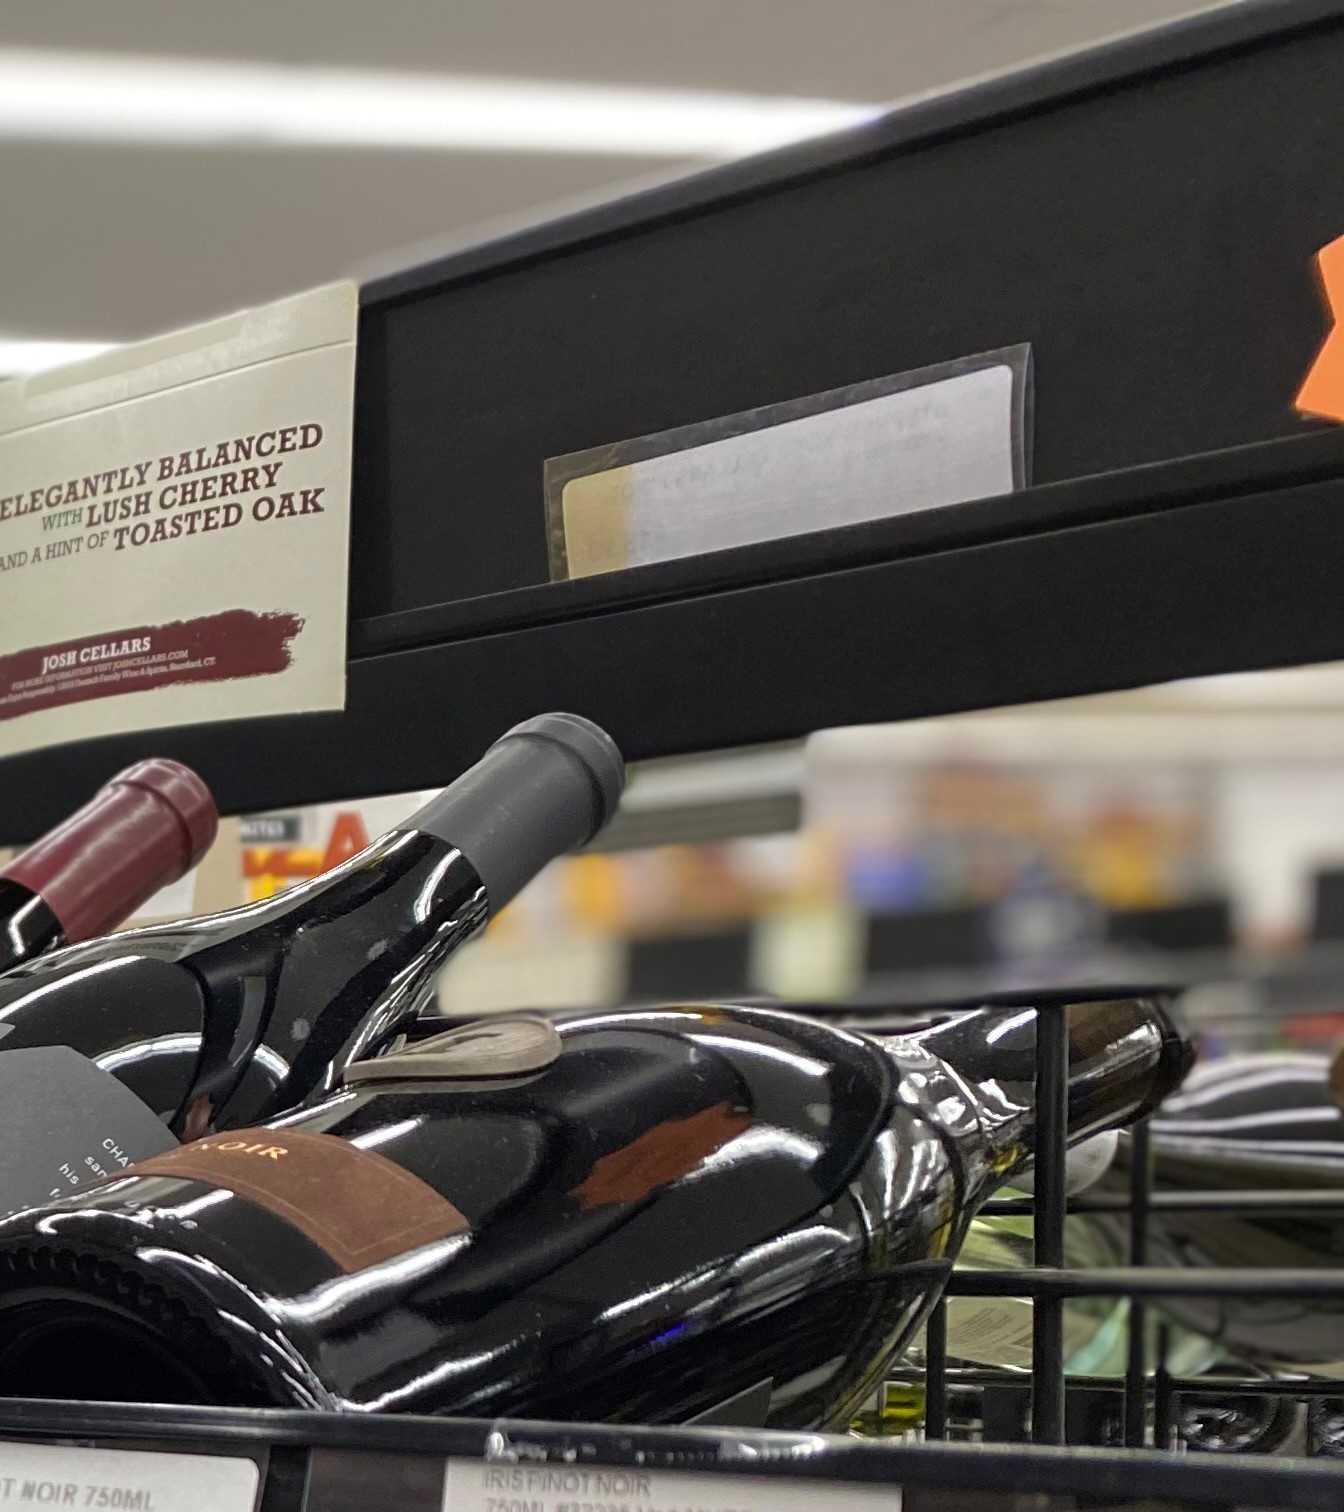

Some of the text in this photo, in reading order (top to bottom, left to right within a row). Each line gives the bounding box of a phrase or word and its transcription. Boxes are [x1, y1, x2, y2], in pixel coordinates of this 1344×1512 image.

[157, 422, 324, 483] BALANCED
[42, 461, 283, 531] WITH LUSH CHERRY
[31, 546, 42, 563] A
[45, 537, 83, 559] HINT
[87, 531, 109, 550] OF
[113, 503, 243, 551] TOASTED
[251, 488, 325, 523] OAK
[42, 636, 151, 675] JOSH CELLARS
[58, 1163, 80, 1186] his
[20, 1480, 78, 1505] NOIR
[483, 1468, 653, 1498] IRIS PINOT NOIR
